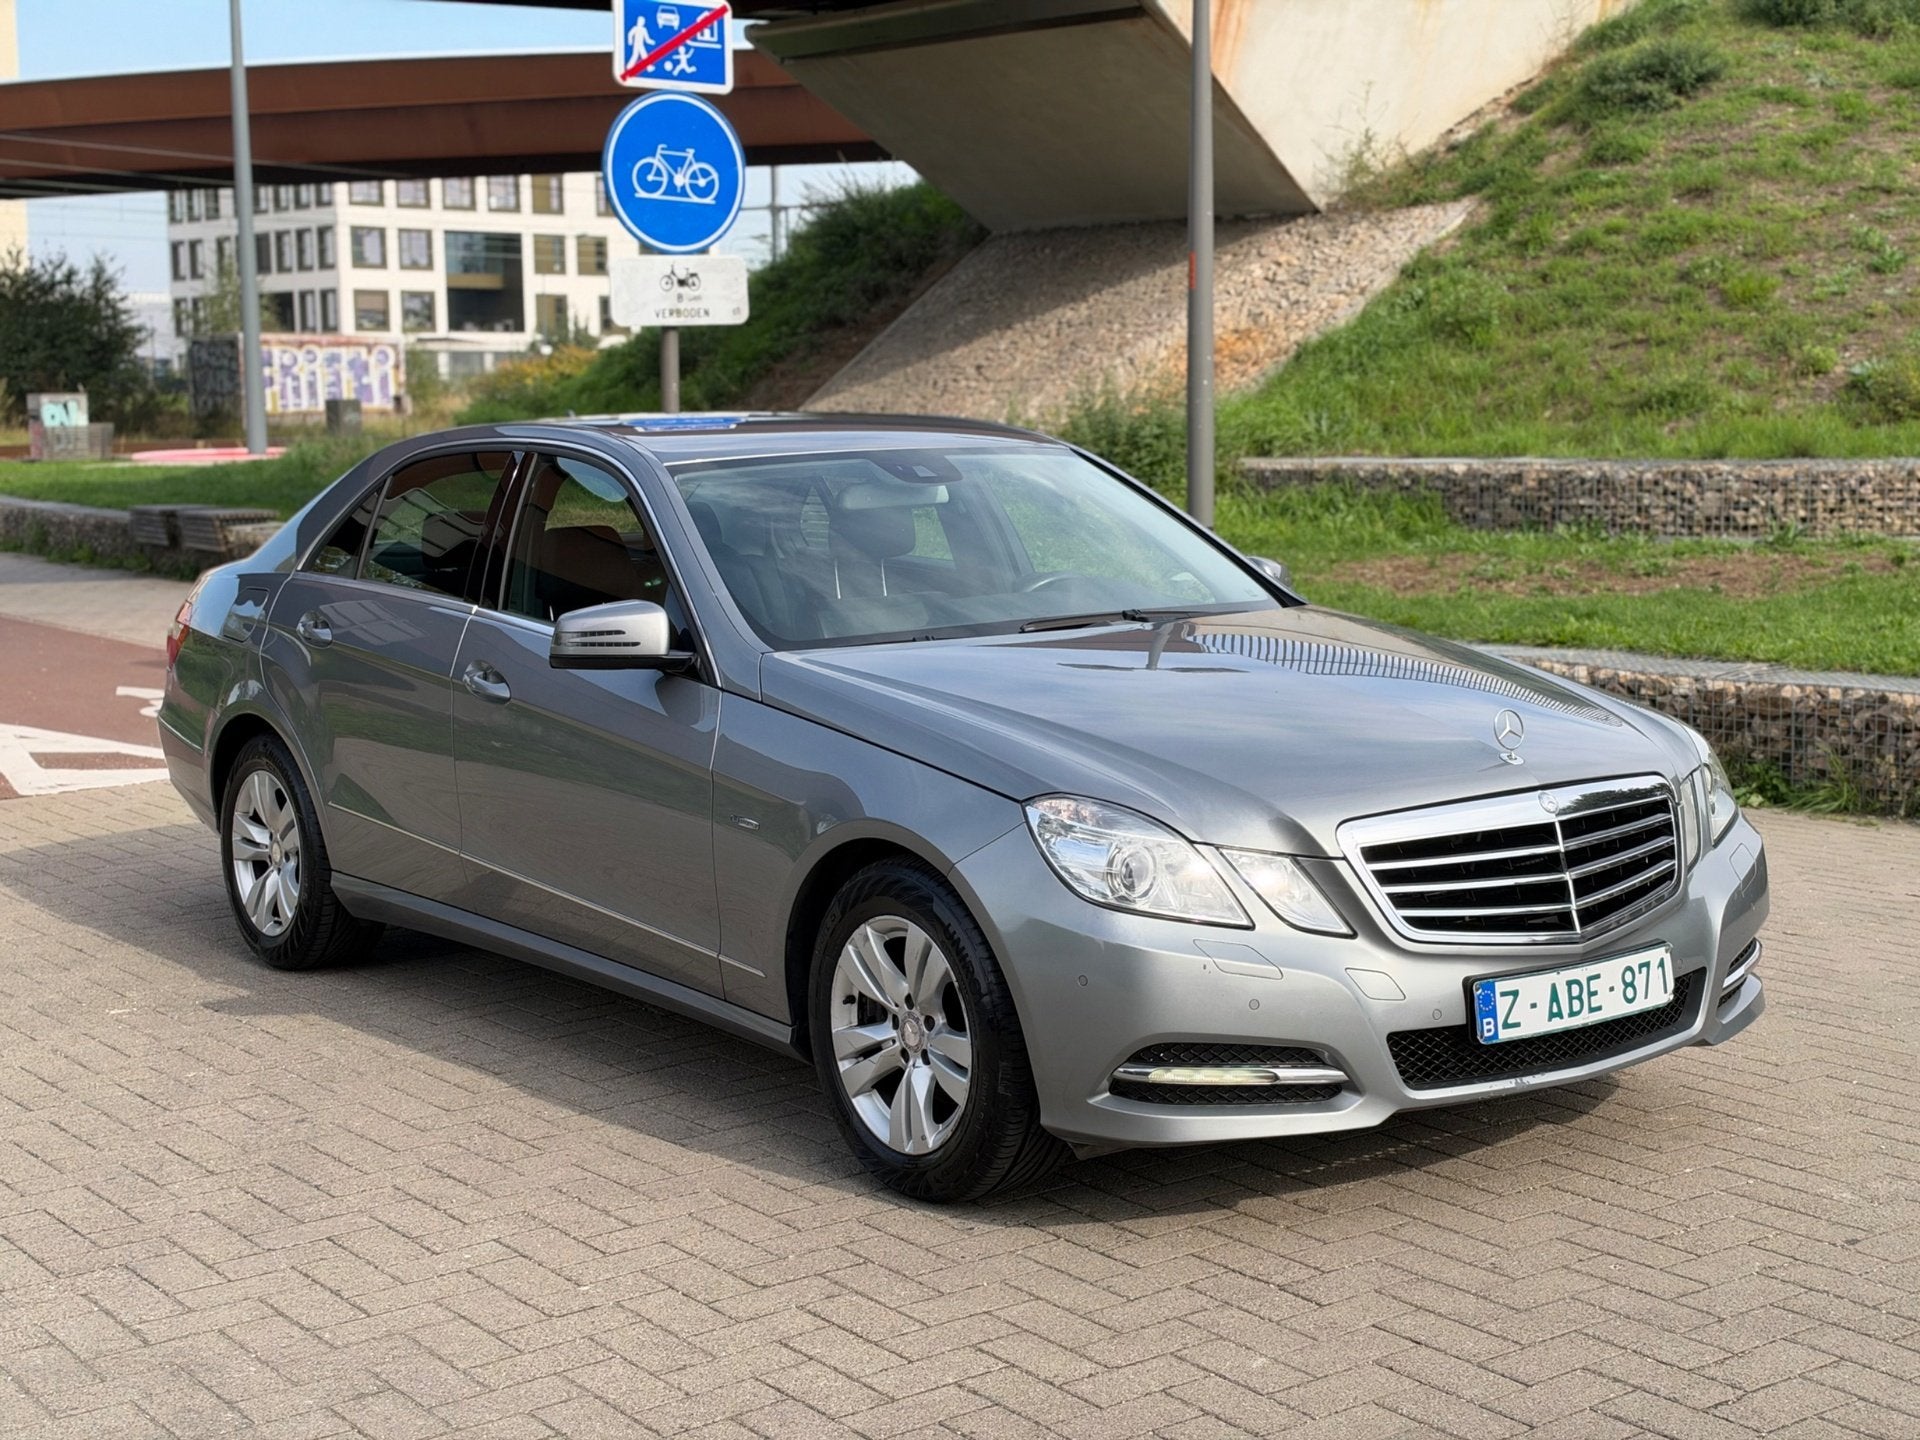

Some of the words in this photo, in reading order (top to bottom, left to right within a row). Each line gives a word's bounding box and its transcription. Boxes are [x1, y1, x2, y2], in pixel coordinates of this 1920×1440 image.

[654, 307, 710, 319] VERBODEN
[1499, 957, 1668, 1030] Z-ABE-871
[1482, 1017, 1495, 1037] B
